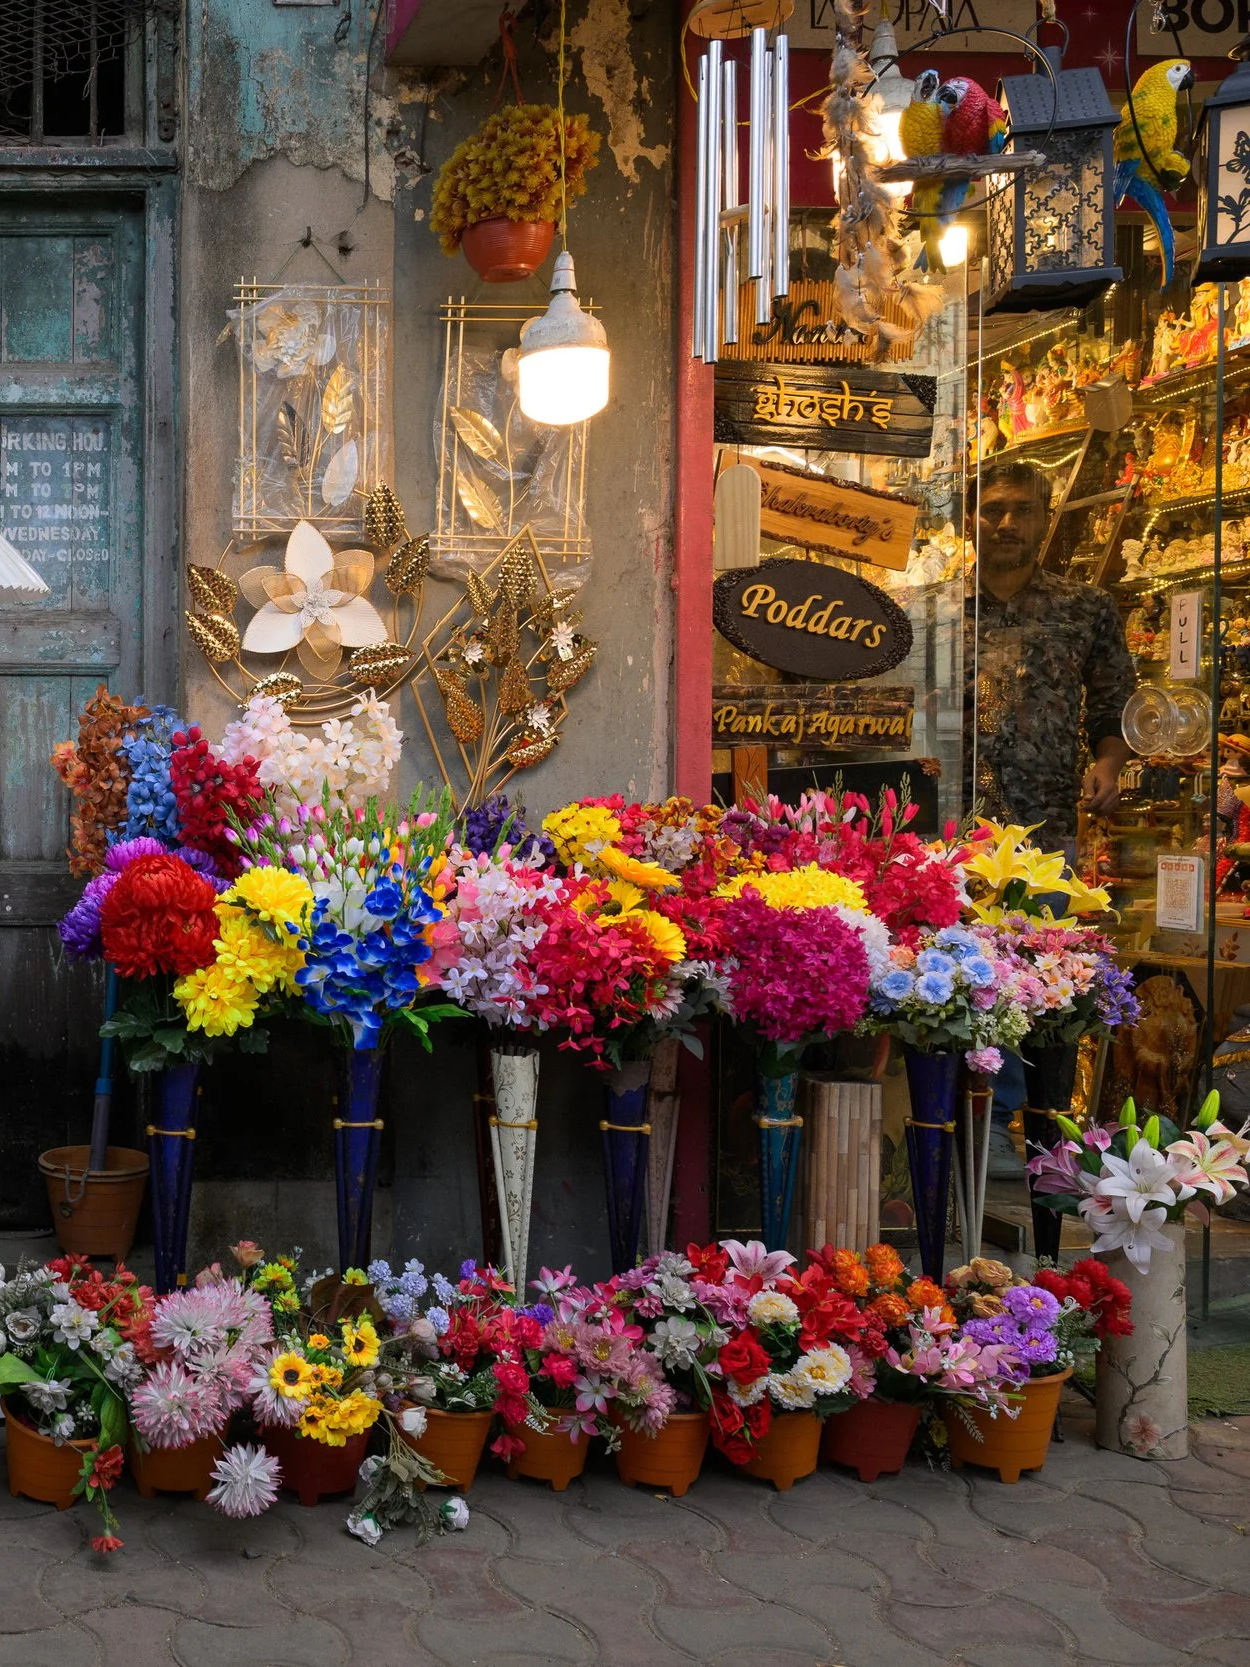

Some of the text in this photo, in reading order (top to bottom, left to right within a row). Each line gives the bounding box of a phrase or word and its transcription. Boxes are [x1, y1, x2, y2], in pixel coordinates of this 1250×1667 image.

[30, 462, 52, 478] TO
[31, 483, 51, 498] TO
[10, 505, 32, 519] TO
[741, 584, 886, 649] Poddars
[1179, 599, 1188, 663] PULL
[713, 703, 915, 746] Pankaj Agarwal
